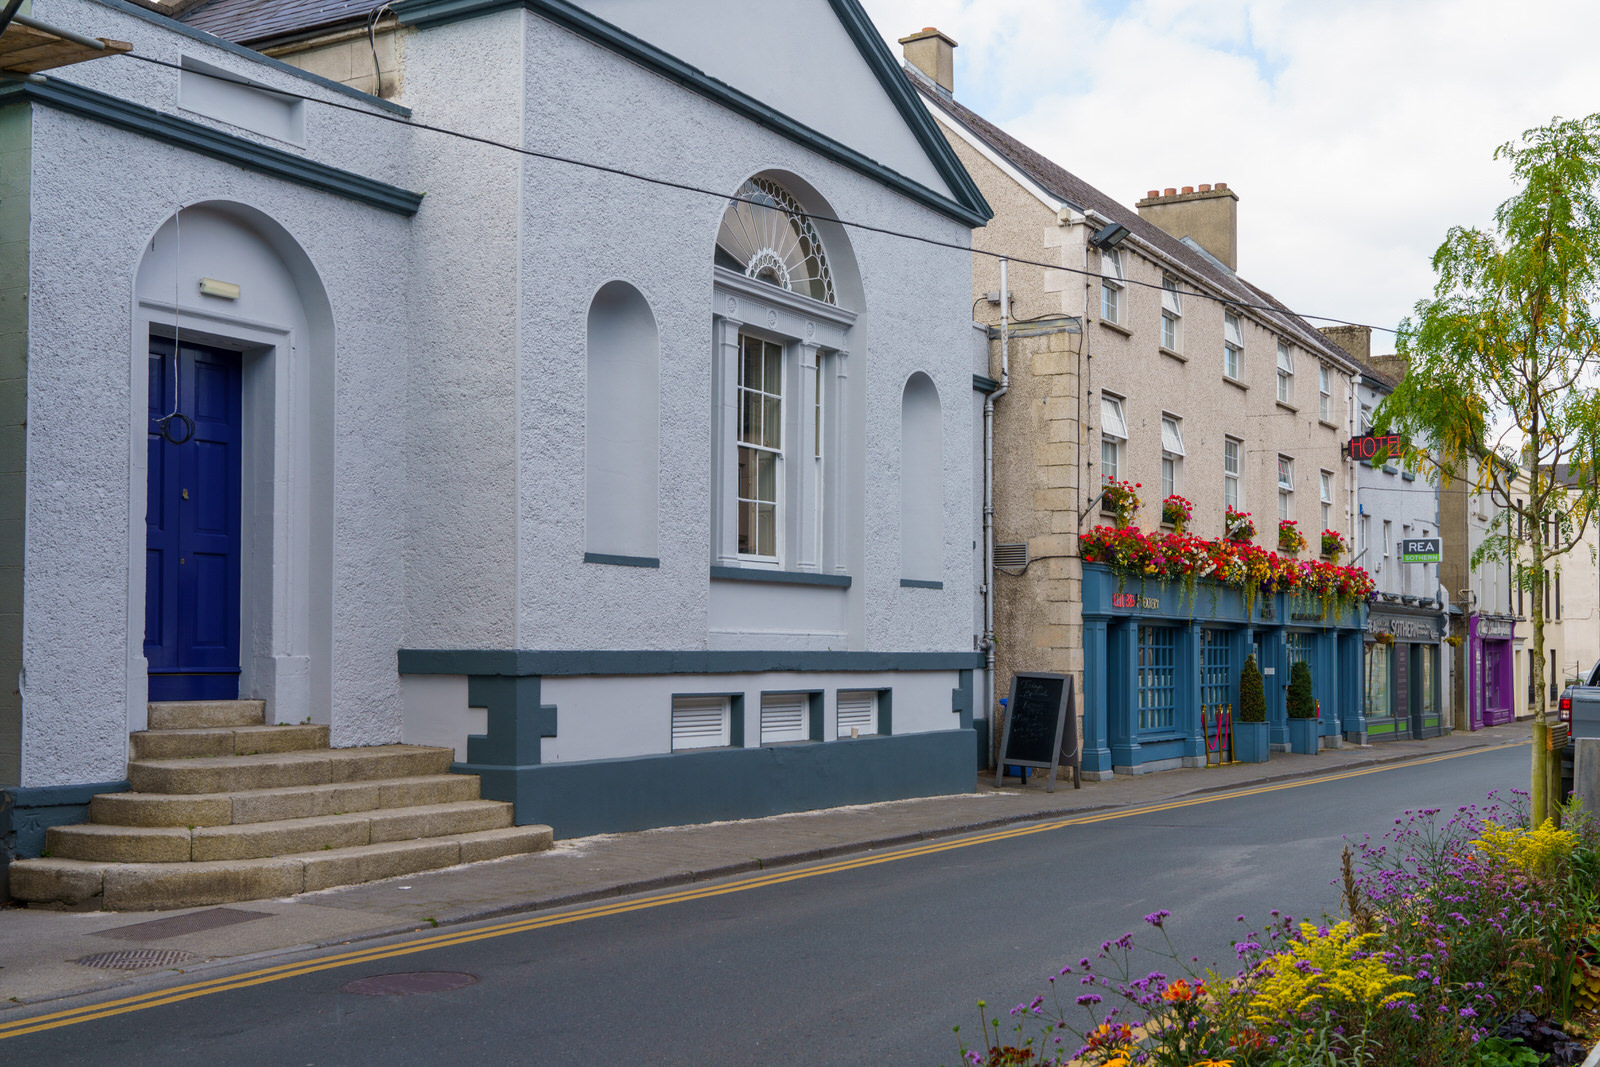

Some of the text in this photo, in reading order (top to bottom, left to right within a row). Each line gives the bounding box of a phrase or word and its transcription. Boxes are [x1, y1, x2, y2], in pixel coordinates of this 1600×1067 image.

[1351, 435, 1401, 459] HOTEL
[1408, 541, 1435, 552] REA
[1391, 619, 1418, 638] SOTHERN
